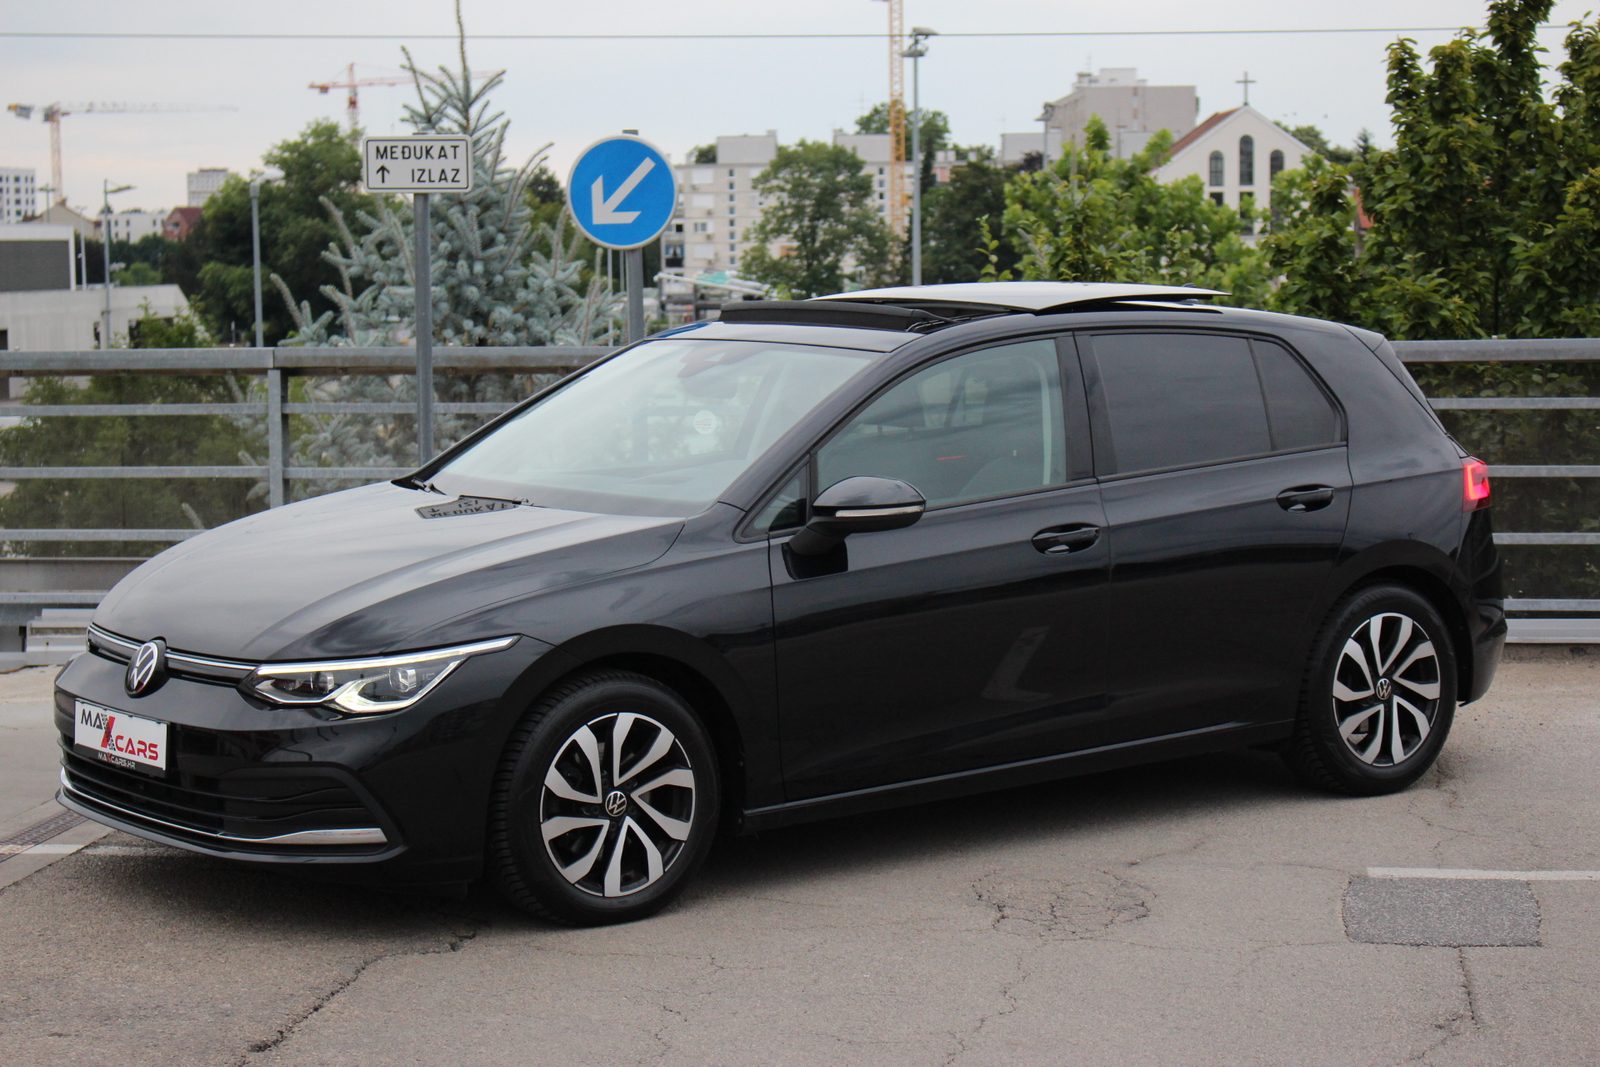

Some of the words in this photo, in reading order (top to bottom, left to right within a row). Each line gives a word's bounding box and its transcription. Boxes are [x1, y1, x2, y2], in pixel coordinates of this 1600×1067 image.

[375, 145, 460, 160] MEĐUKAT
[411, 168, 461, 183] IZLAZ
[115, 734, 159, 761] CARS
